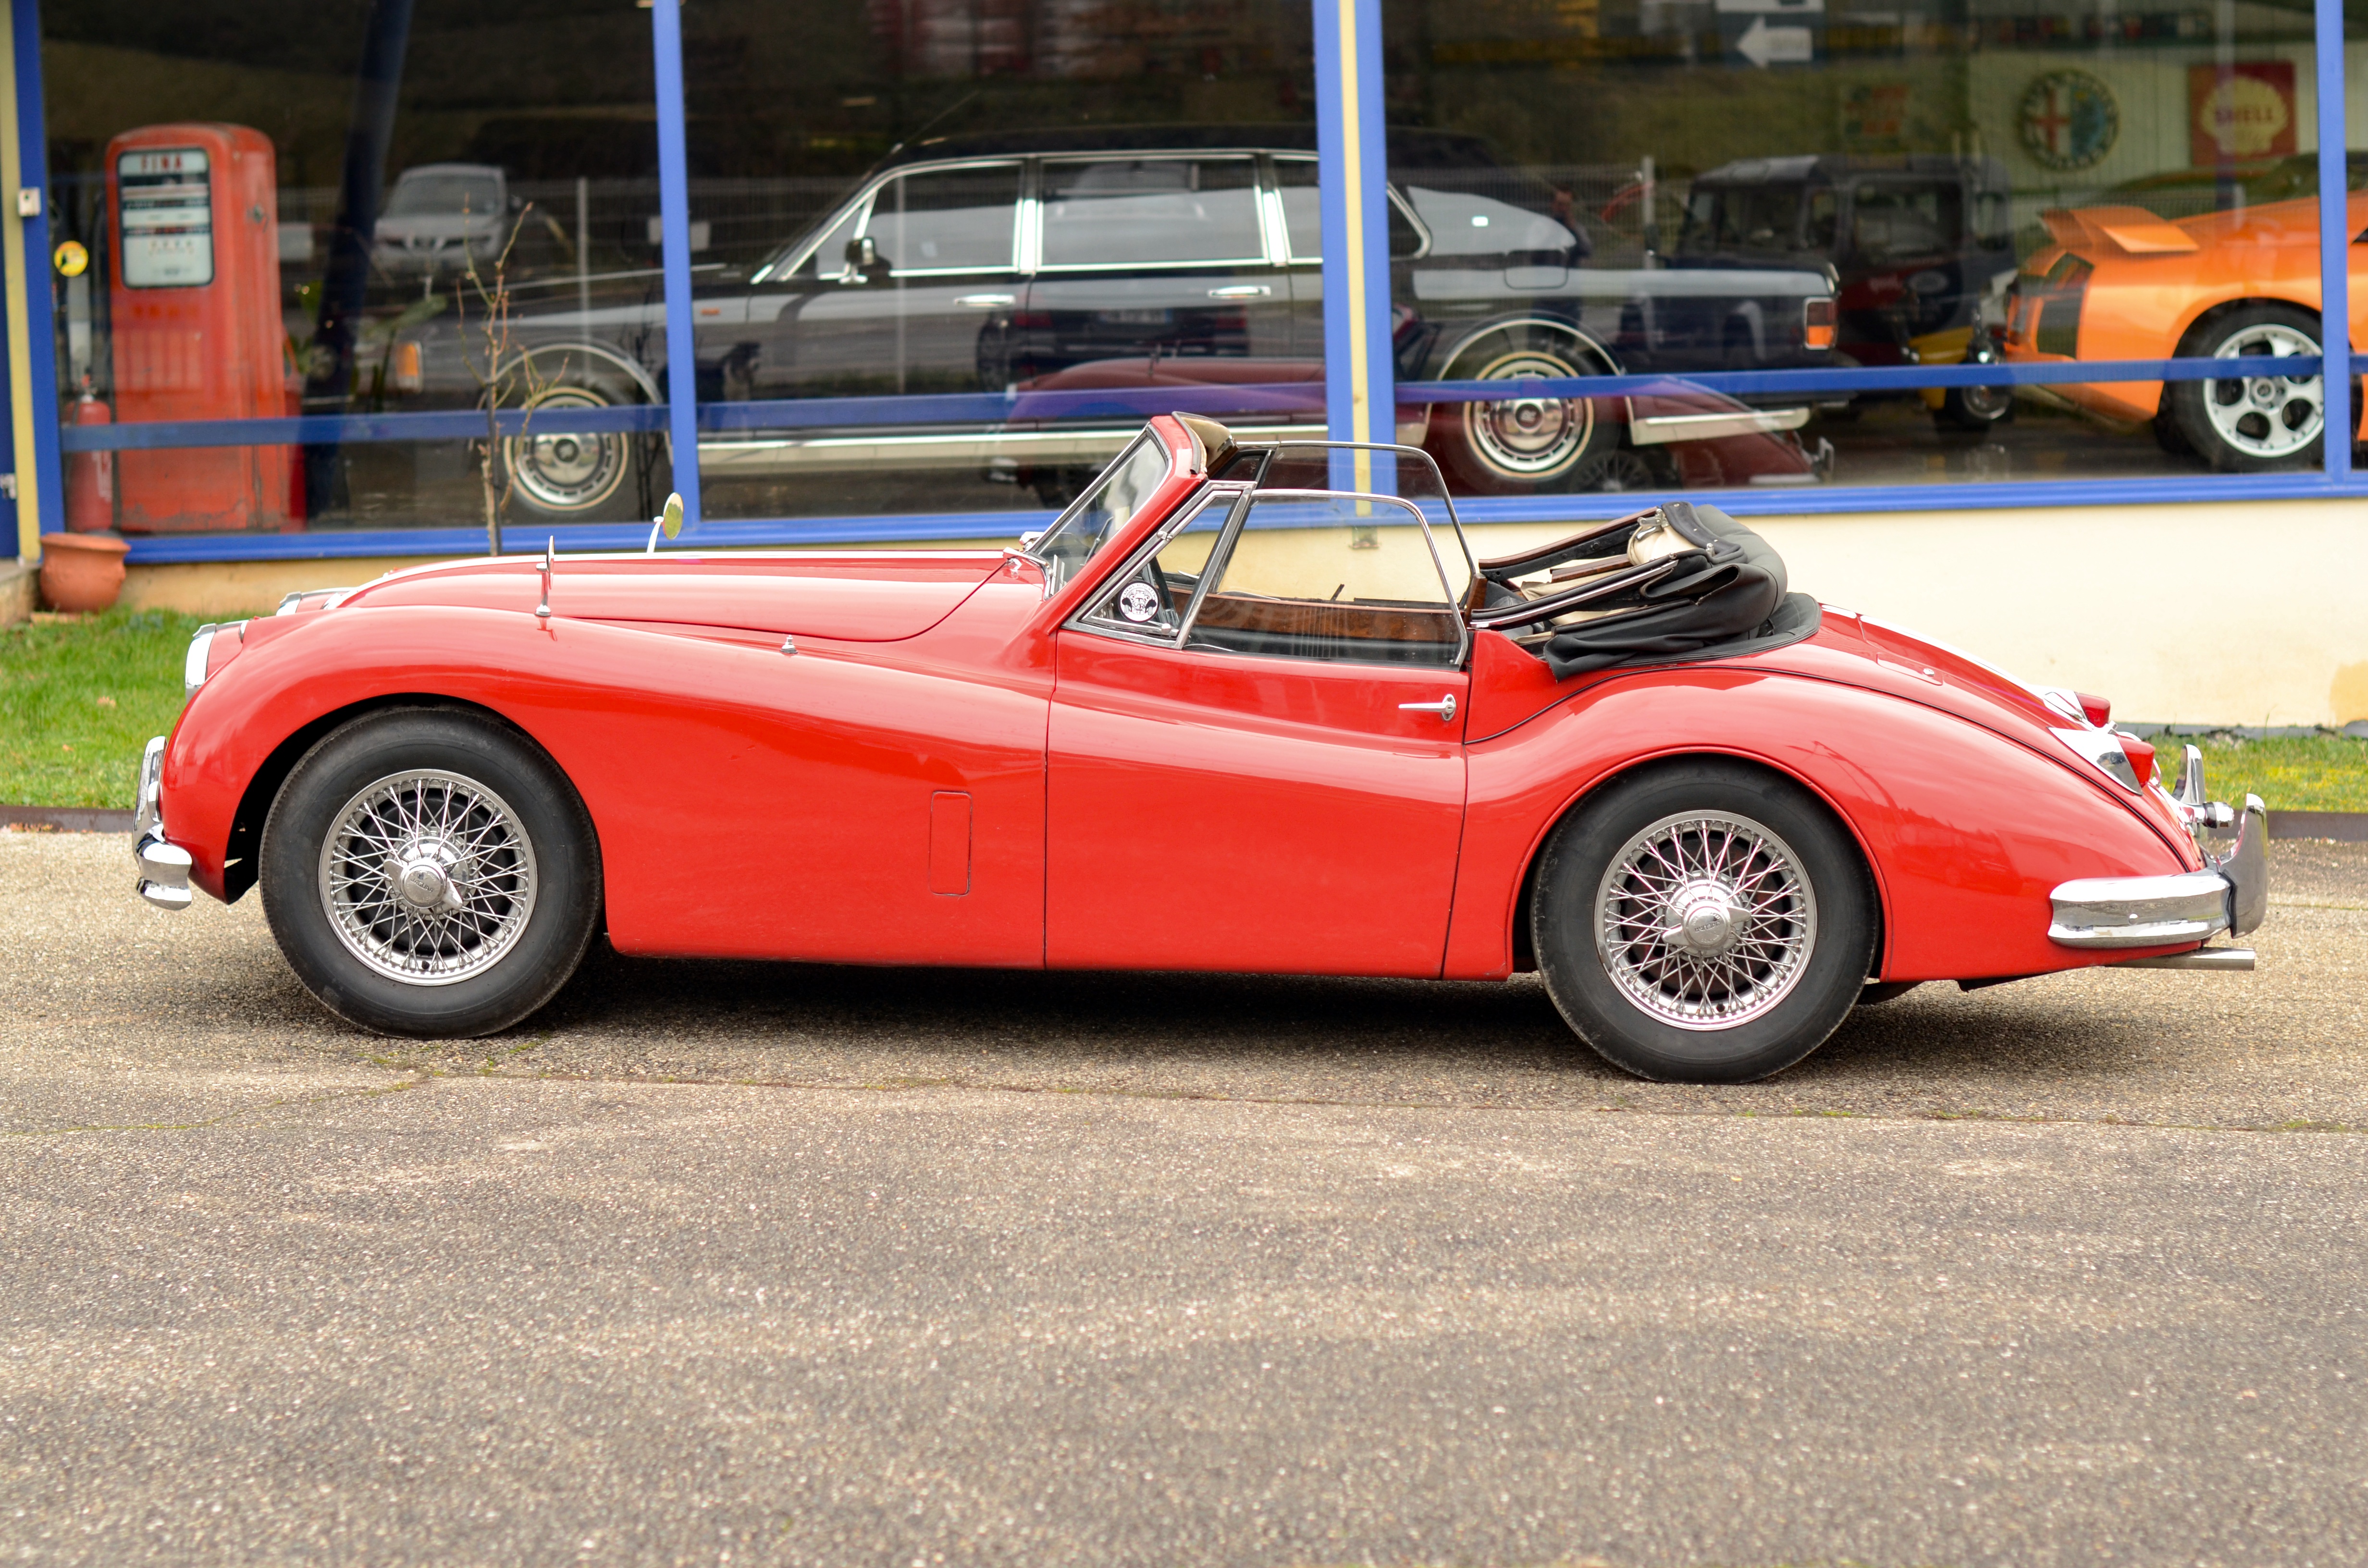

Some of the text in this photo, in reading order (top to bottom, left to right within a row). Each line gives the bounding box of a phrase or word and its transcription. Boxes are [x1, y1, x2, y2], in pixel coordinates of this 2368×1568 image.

[2215, 107, 2274, 125] SHELL
[141, 154, 183, 171] FINA
[410, 878, 434, 893] JAGUAR
[1694, 921, 1720, 933] JAGUAR
